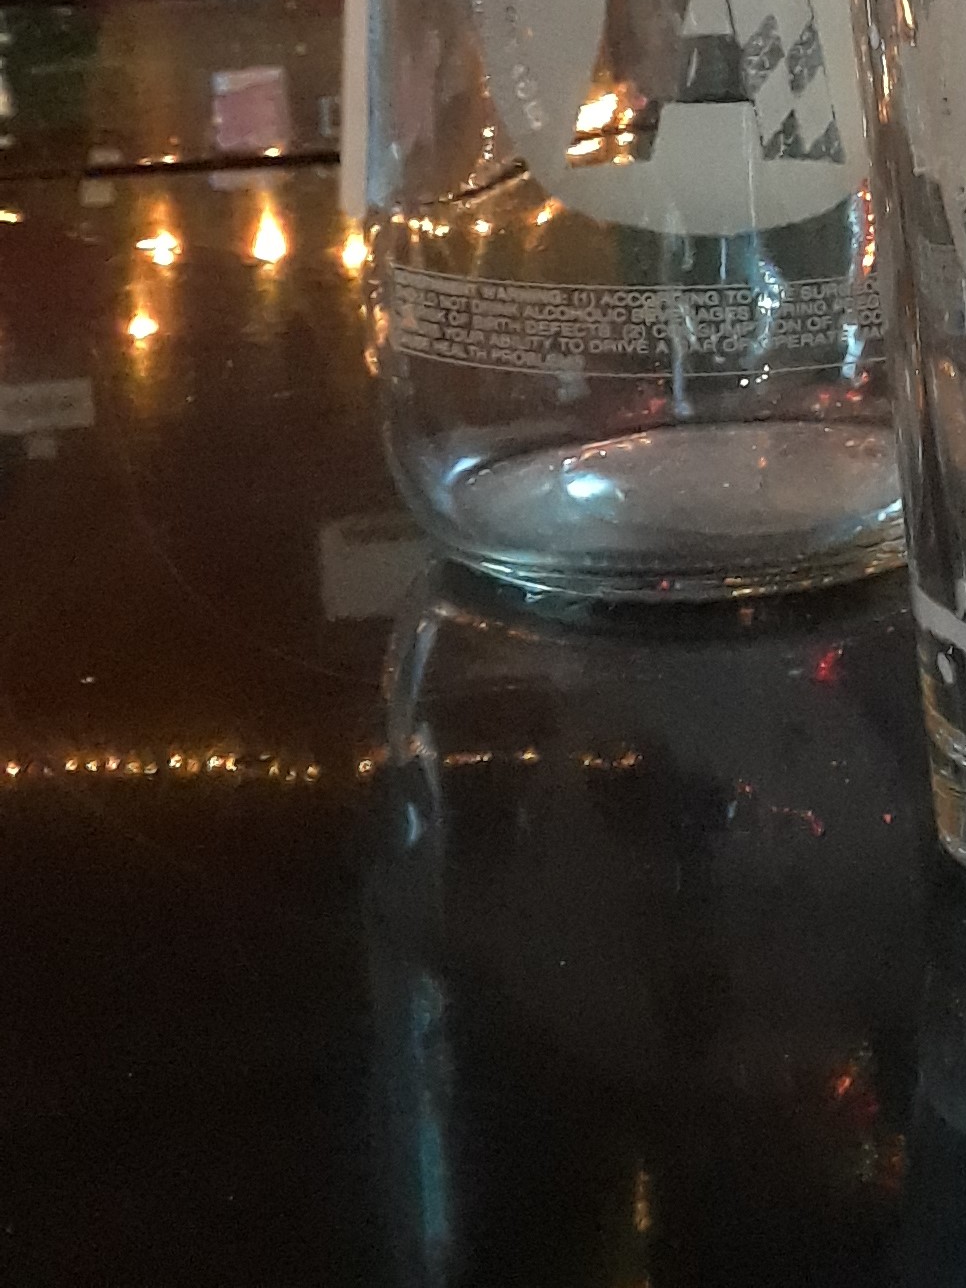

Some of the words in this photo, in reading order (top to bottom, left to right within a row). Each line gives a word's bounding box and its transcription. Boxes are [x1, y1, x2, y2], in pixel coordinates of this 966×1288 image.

[724, 290, 752, 304] TO
[806, 315, 833, 331] OF
[558, 337, 584, 354] TO
